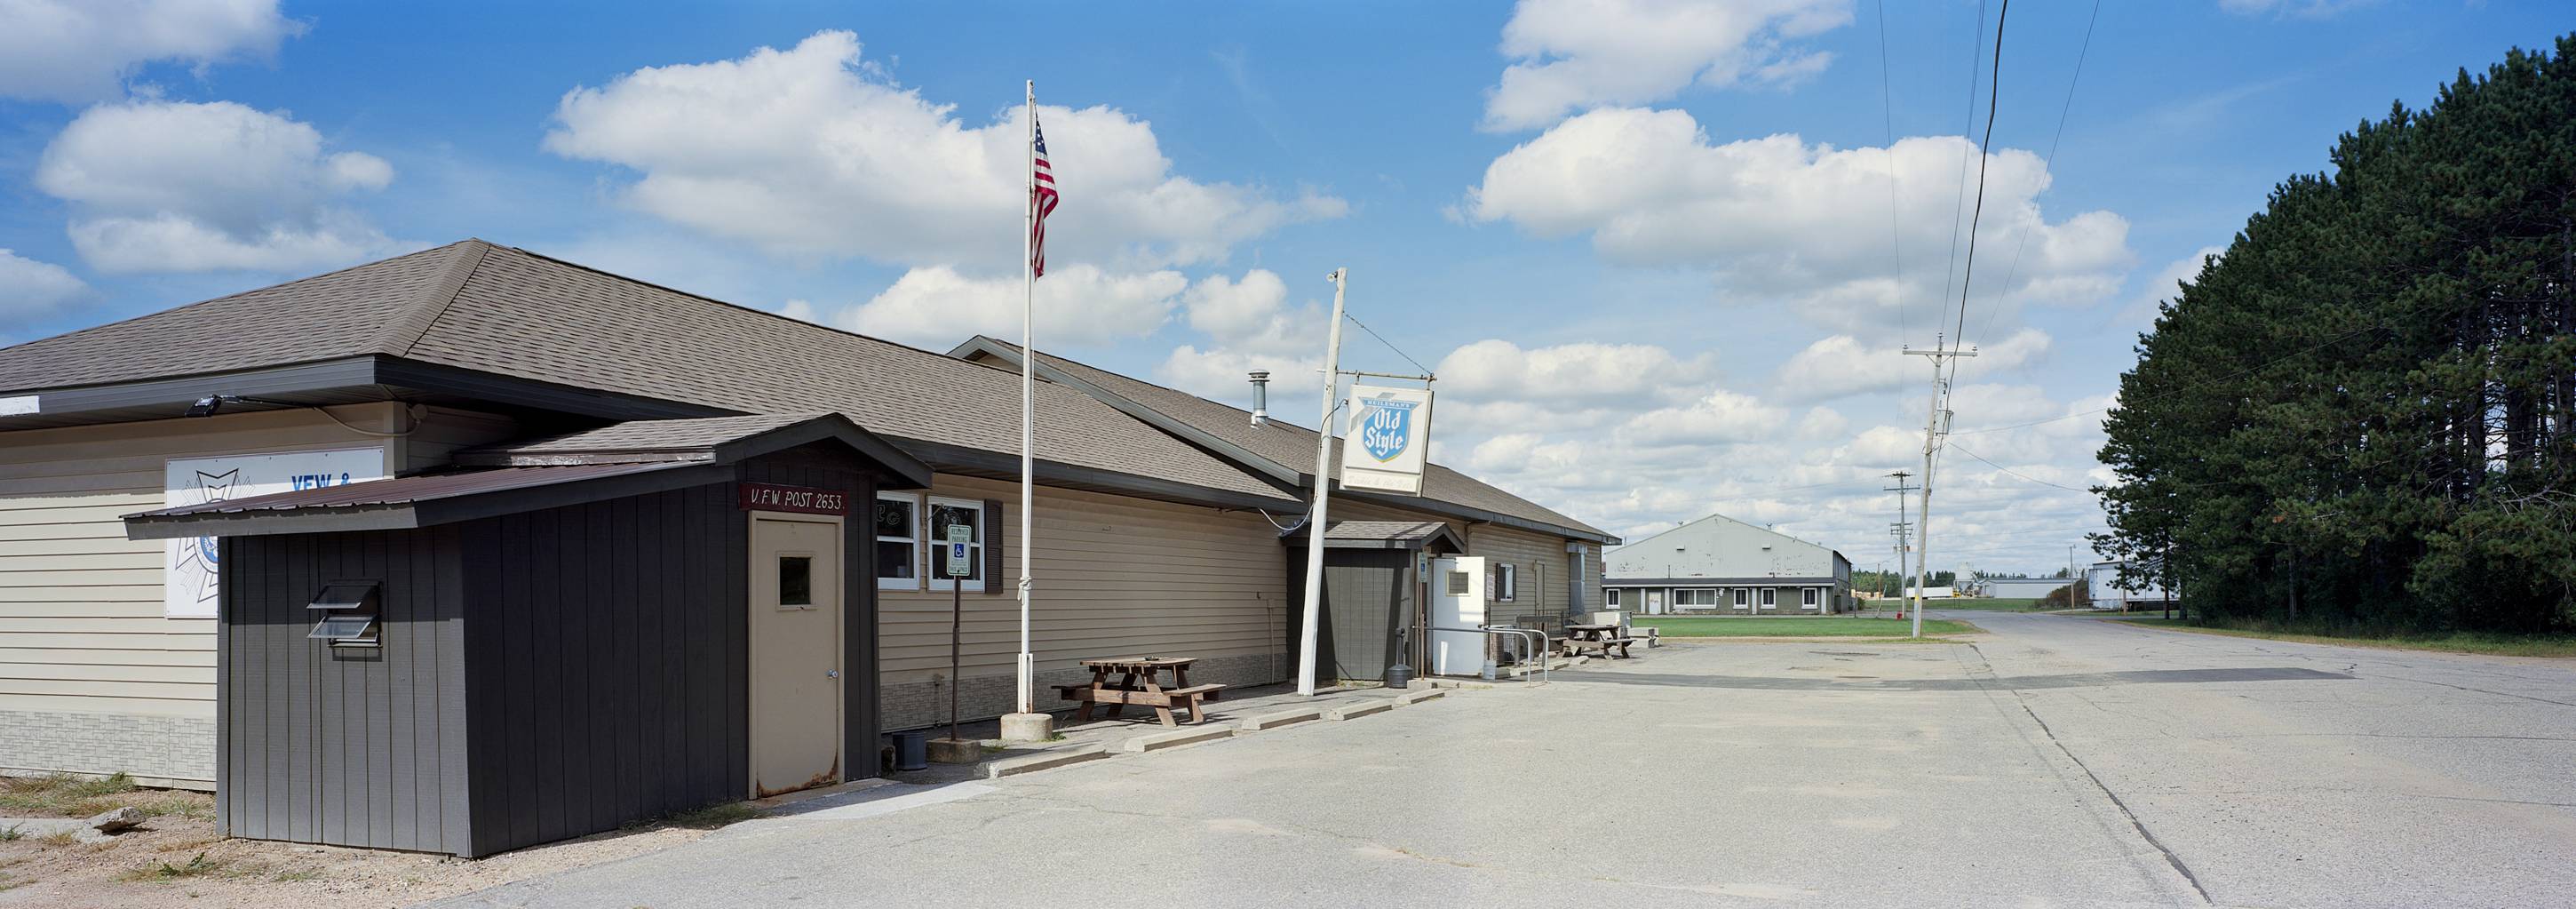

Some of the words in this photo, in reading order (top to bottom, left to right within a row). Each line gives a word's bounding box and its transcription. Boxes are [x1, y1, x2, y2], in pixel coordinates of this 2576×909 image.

[1374, 408, 1402, 430] Old
[1364, 426, 1403, 457] Style
[291, 474, 332, 491] VFW
[340, 472, 352, 485] &
[784, 490, 813, 507] POST
